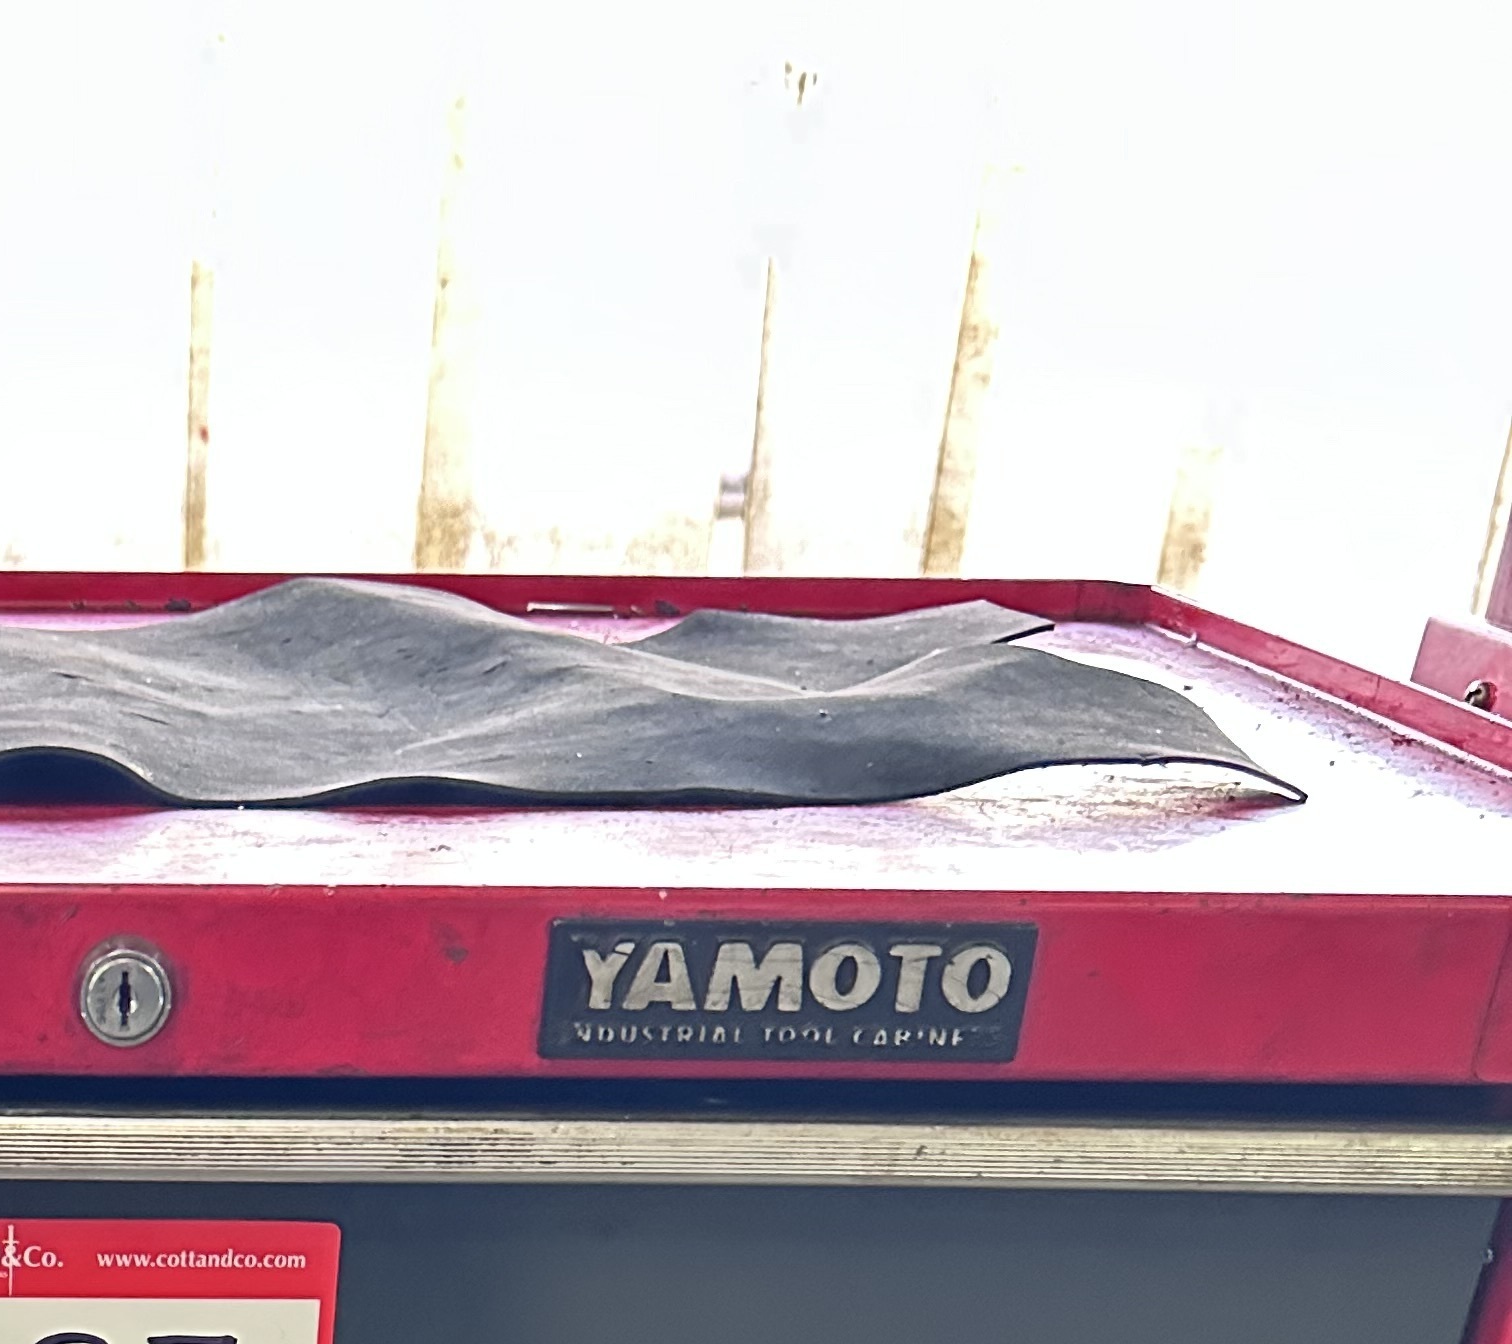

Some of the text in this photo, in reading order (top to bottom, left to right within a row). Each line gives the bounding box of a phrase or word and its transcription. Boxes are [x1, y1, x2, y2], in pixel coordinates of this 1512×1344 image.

[581, 941, 1012, 1013] YAMOTO
[561, 1022, 742, 1045] NDUSTRIAL
[96, 1248, 307, 1270] www.cottandco.com
